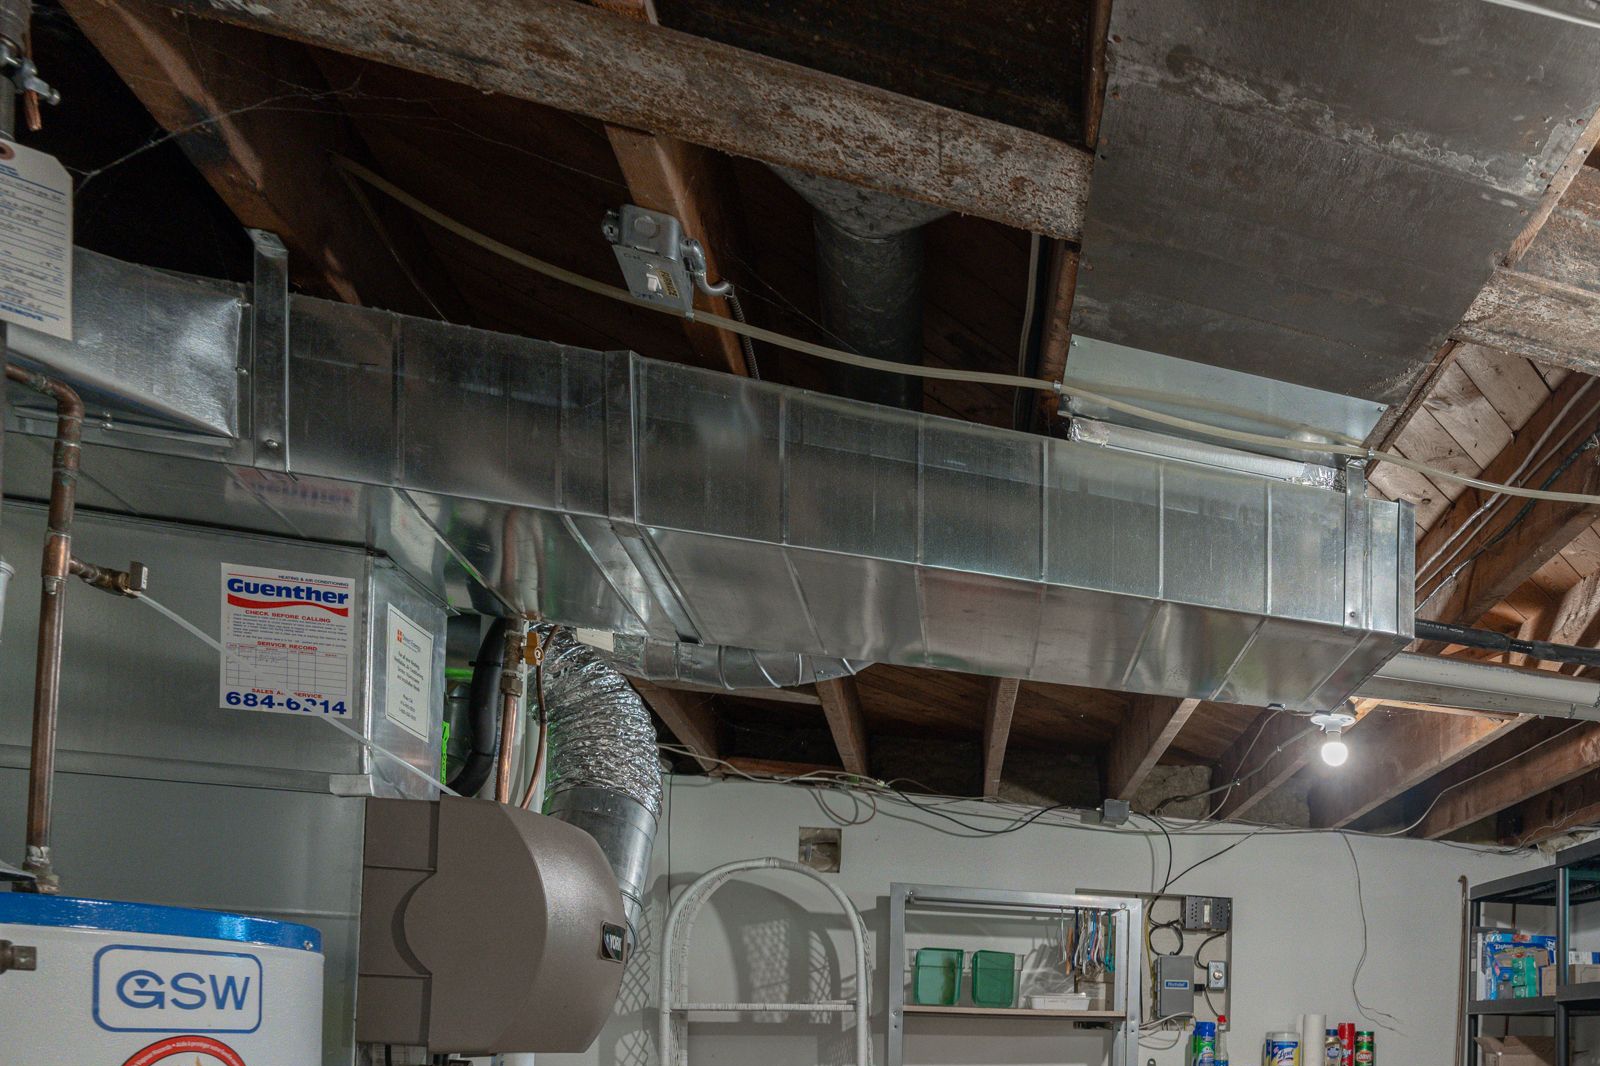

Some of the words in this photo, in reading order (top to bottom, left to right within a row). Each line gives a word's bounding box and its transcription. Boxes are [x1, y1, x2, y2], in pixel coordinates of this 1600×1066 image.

[227, 578, 349, 605] Guenther
[271, 612, 300, 620] BEFORE
[301, 615, 331, 623] CALLING
[256, 640, 287, 648] SERVICE
[116, 969, 251, 1010] GSW
